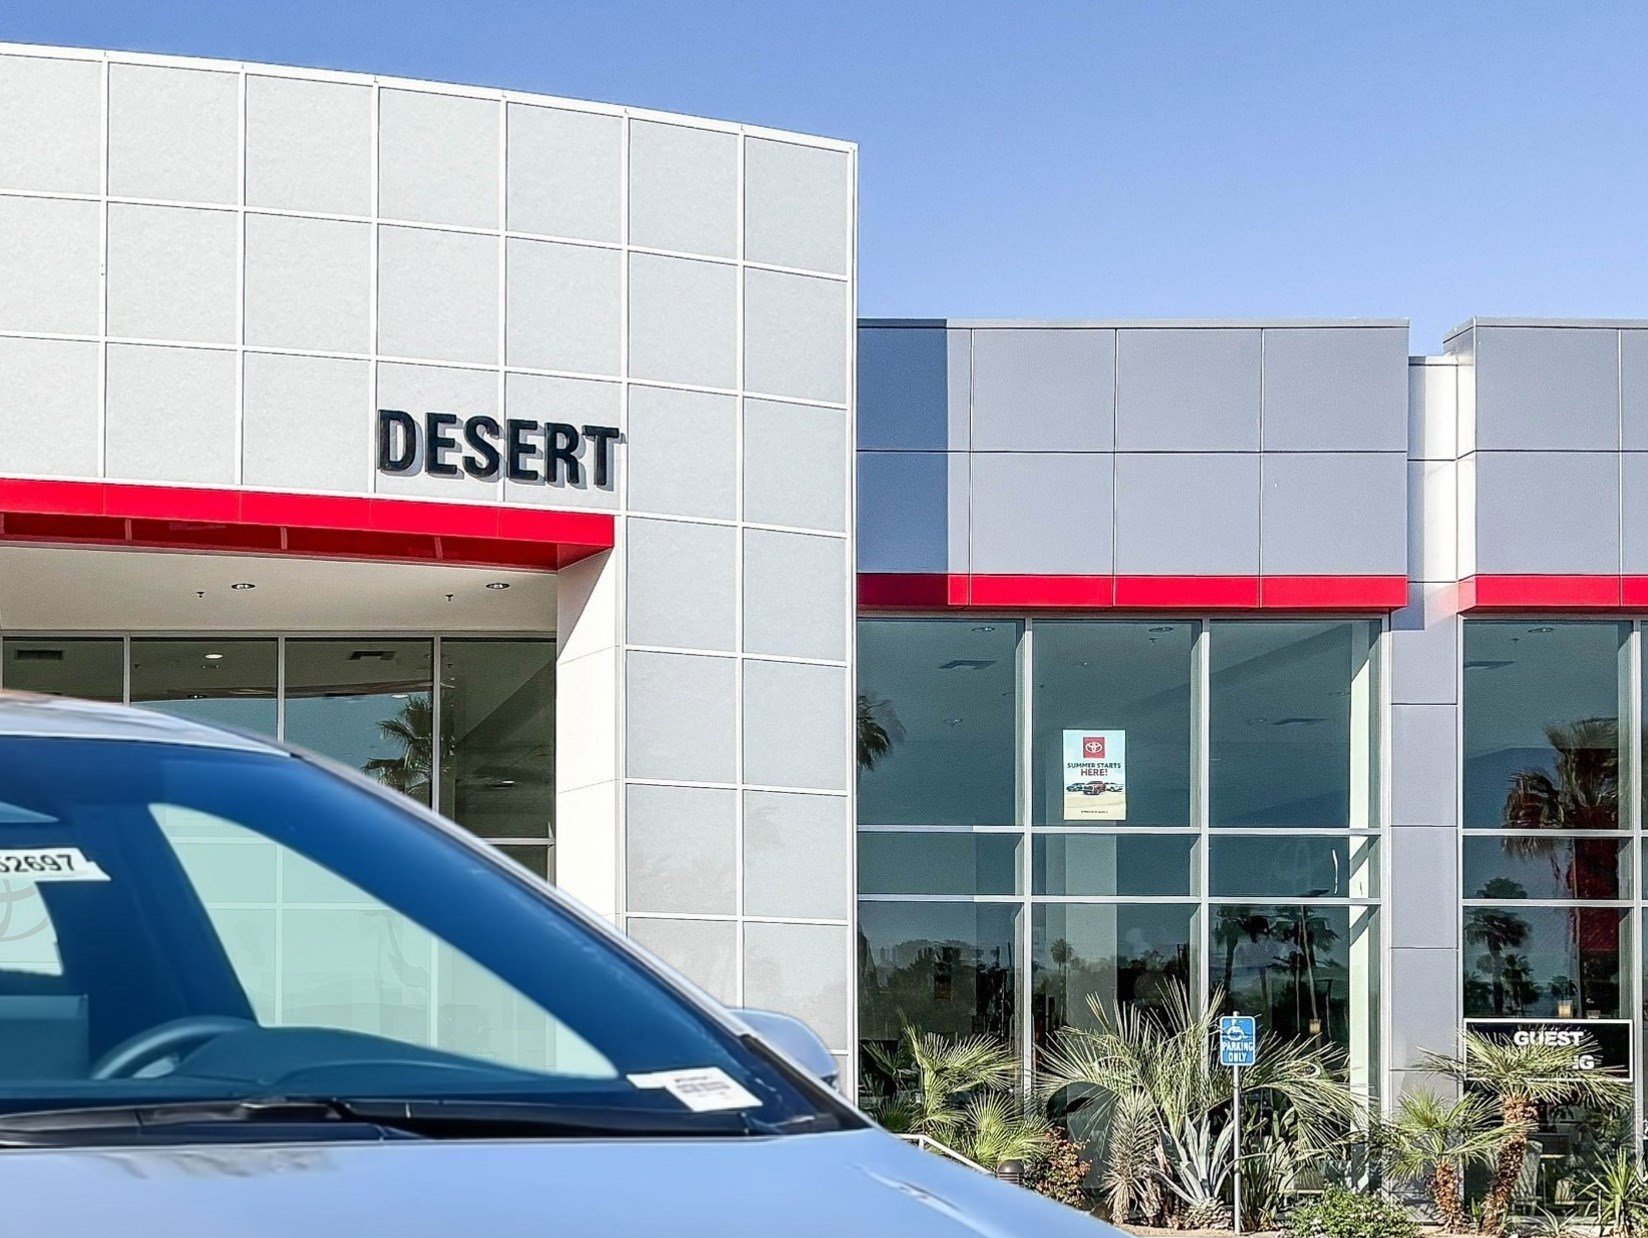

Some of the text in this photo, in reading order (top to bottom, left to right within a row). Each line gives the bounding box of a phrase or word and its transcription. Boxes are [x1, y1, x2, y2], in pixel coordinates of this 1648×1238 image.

[377, 409, 620, 487] DESERT
[1513, 1030, 1584, 1046] GUEST
[1222, 1041, 1253, 1051] PARKING
[1228, 1052, 1247, 1062] ONLY
